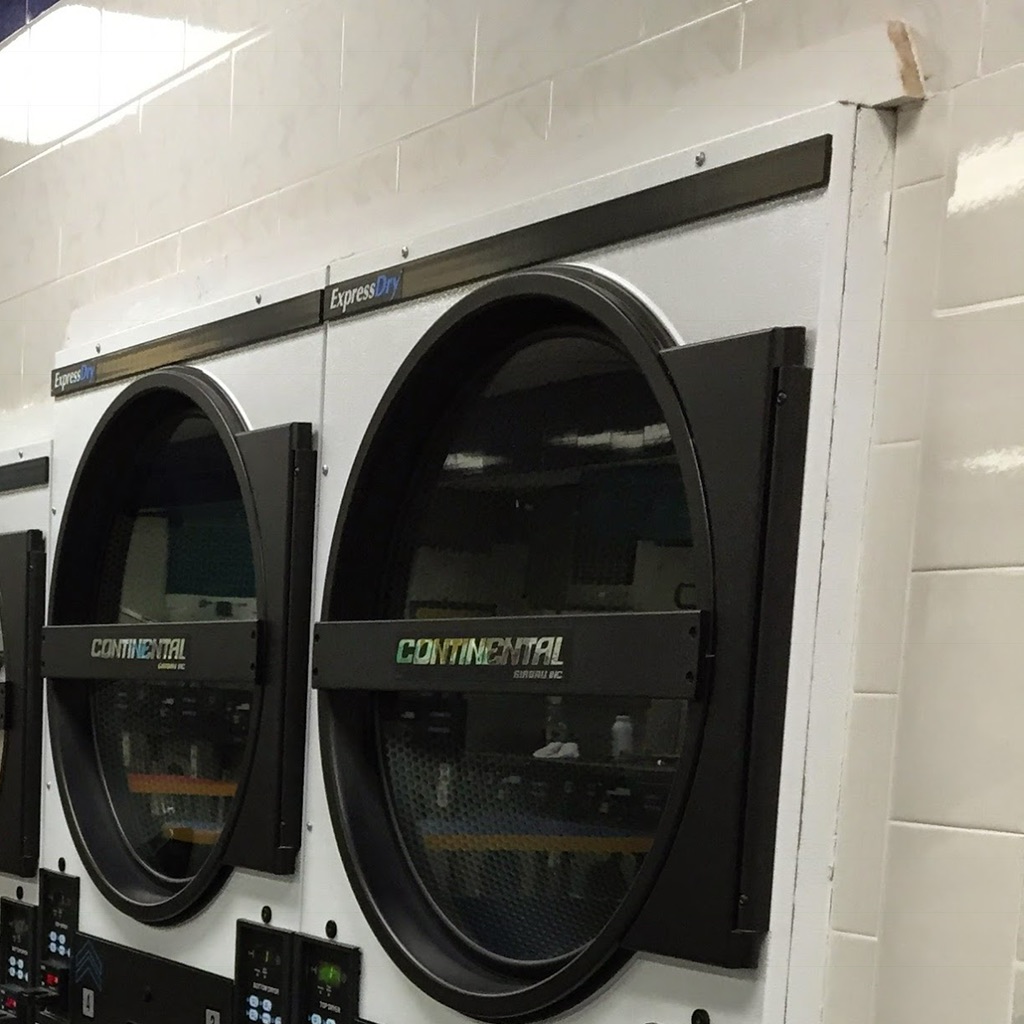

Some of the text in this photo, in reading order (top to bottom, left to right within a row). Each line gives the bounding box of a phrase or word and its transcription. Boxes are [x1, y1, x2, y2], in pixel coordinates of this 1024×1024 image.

[329, 271, 401, 313] ExpressDry
[54, 364, 94, 391] ExpressDry
[91, 638, 186, 660] CONTINENTAL
[396, 636, 564, 666] CONTINENTAL
